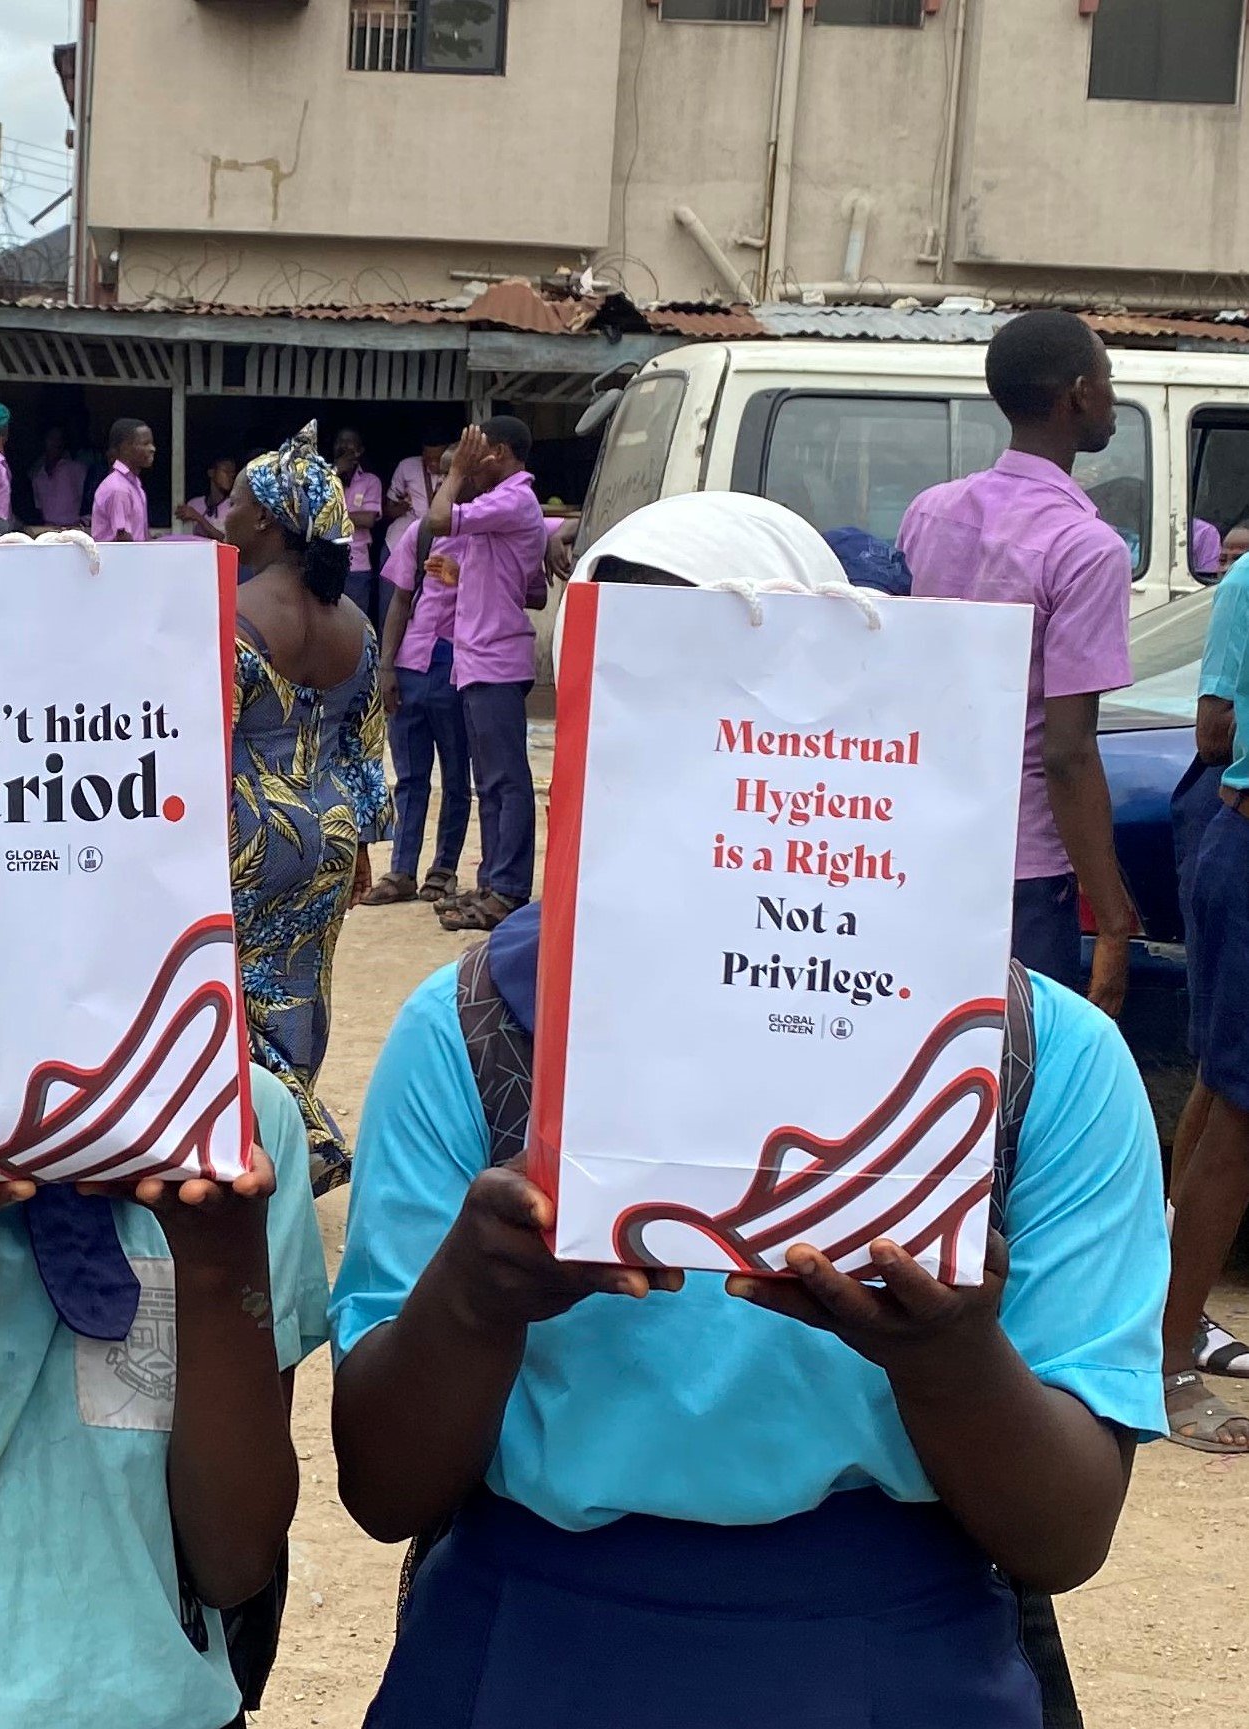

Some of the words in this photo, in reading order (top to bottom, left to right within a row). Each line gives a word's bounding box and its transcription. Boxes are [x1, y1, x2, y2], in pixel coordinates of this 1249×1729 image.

[43, 702, 133, 744] hide
[140, 700, 180, 740] it.
[713, 718, 921, 765] Menstrual
[736, 777, 894, 827] Hygiene
[5, 849, 61, 860] GLOBAL
[6, 861, 59, 872] CITIZEN
[712, 833, 745, 871] is
[752, 847, 774, 872] a
[785, 839, 907, 889] Right,
[755, 895, 828, 934] Not
[836, 911, 858, 936] a
[721, 950, 912, 1007] Privilege.
[768, 1013, 816, 1025] GLOBAL
[768, 1023, 814, 1035] CITIZEN
